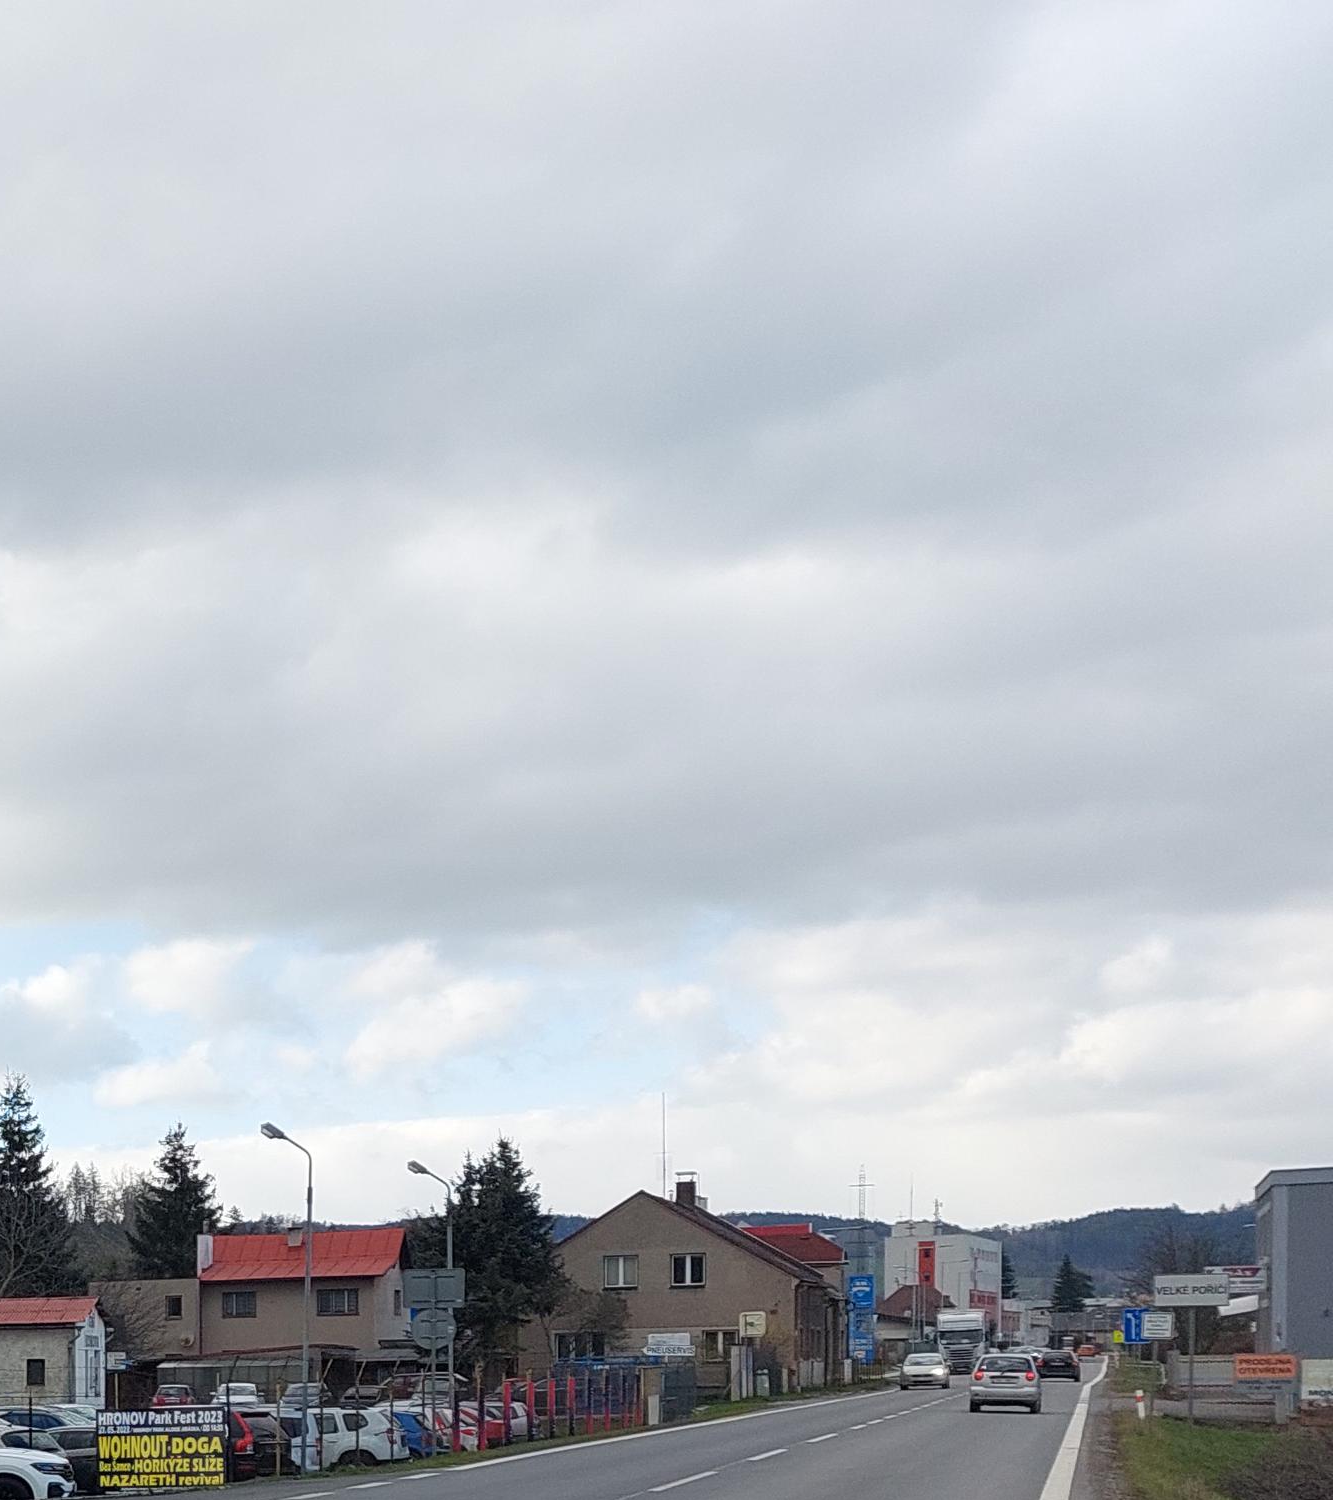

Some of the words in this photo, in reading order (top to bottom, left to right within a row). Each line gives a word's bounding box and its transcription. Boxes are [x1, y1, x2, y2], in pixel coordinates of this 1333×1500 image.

[1156, 1285, 1190, 1295] VELKÉ
[1192, 1284, 1228, 1295] POŘÍČÍ
[1238, 1366, 1292, 1374] OTEVŘENA
[98, 1412, 146, 1425] HRONOV
[149, 1411, 172, 1425] Park
[174, 1411, 196, 1424] Fest
[198, 1411, 223, 1423] 2023
[98, 1435, 169, 1459] WOHNOUT
[171, 1437, 223, 1454] DOGA
[134, 1456, 190, 1473] HORKÝŽE
[192, 1455, 224, 1472] SLÍŽE
[100, 1474, 176, 1487] NAZARETH
[179, 1474, 224, 1486] revival
